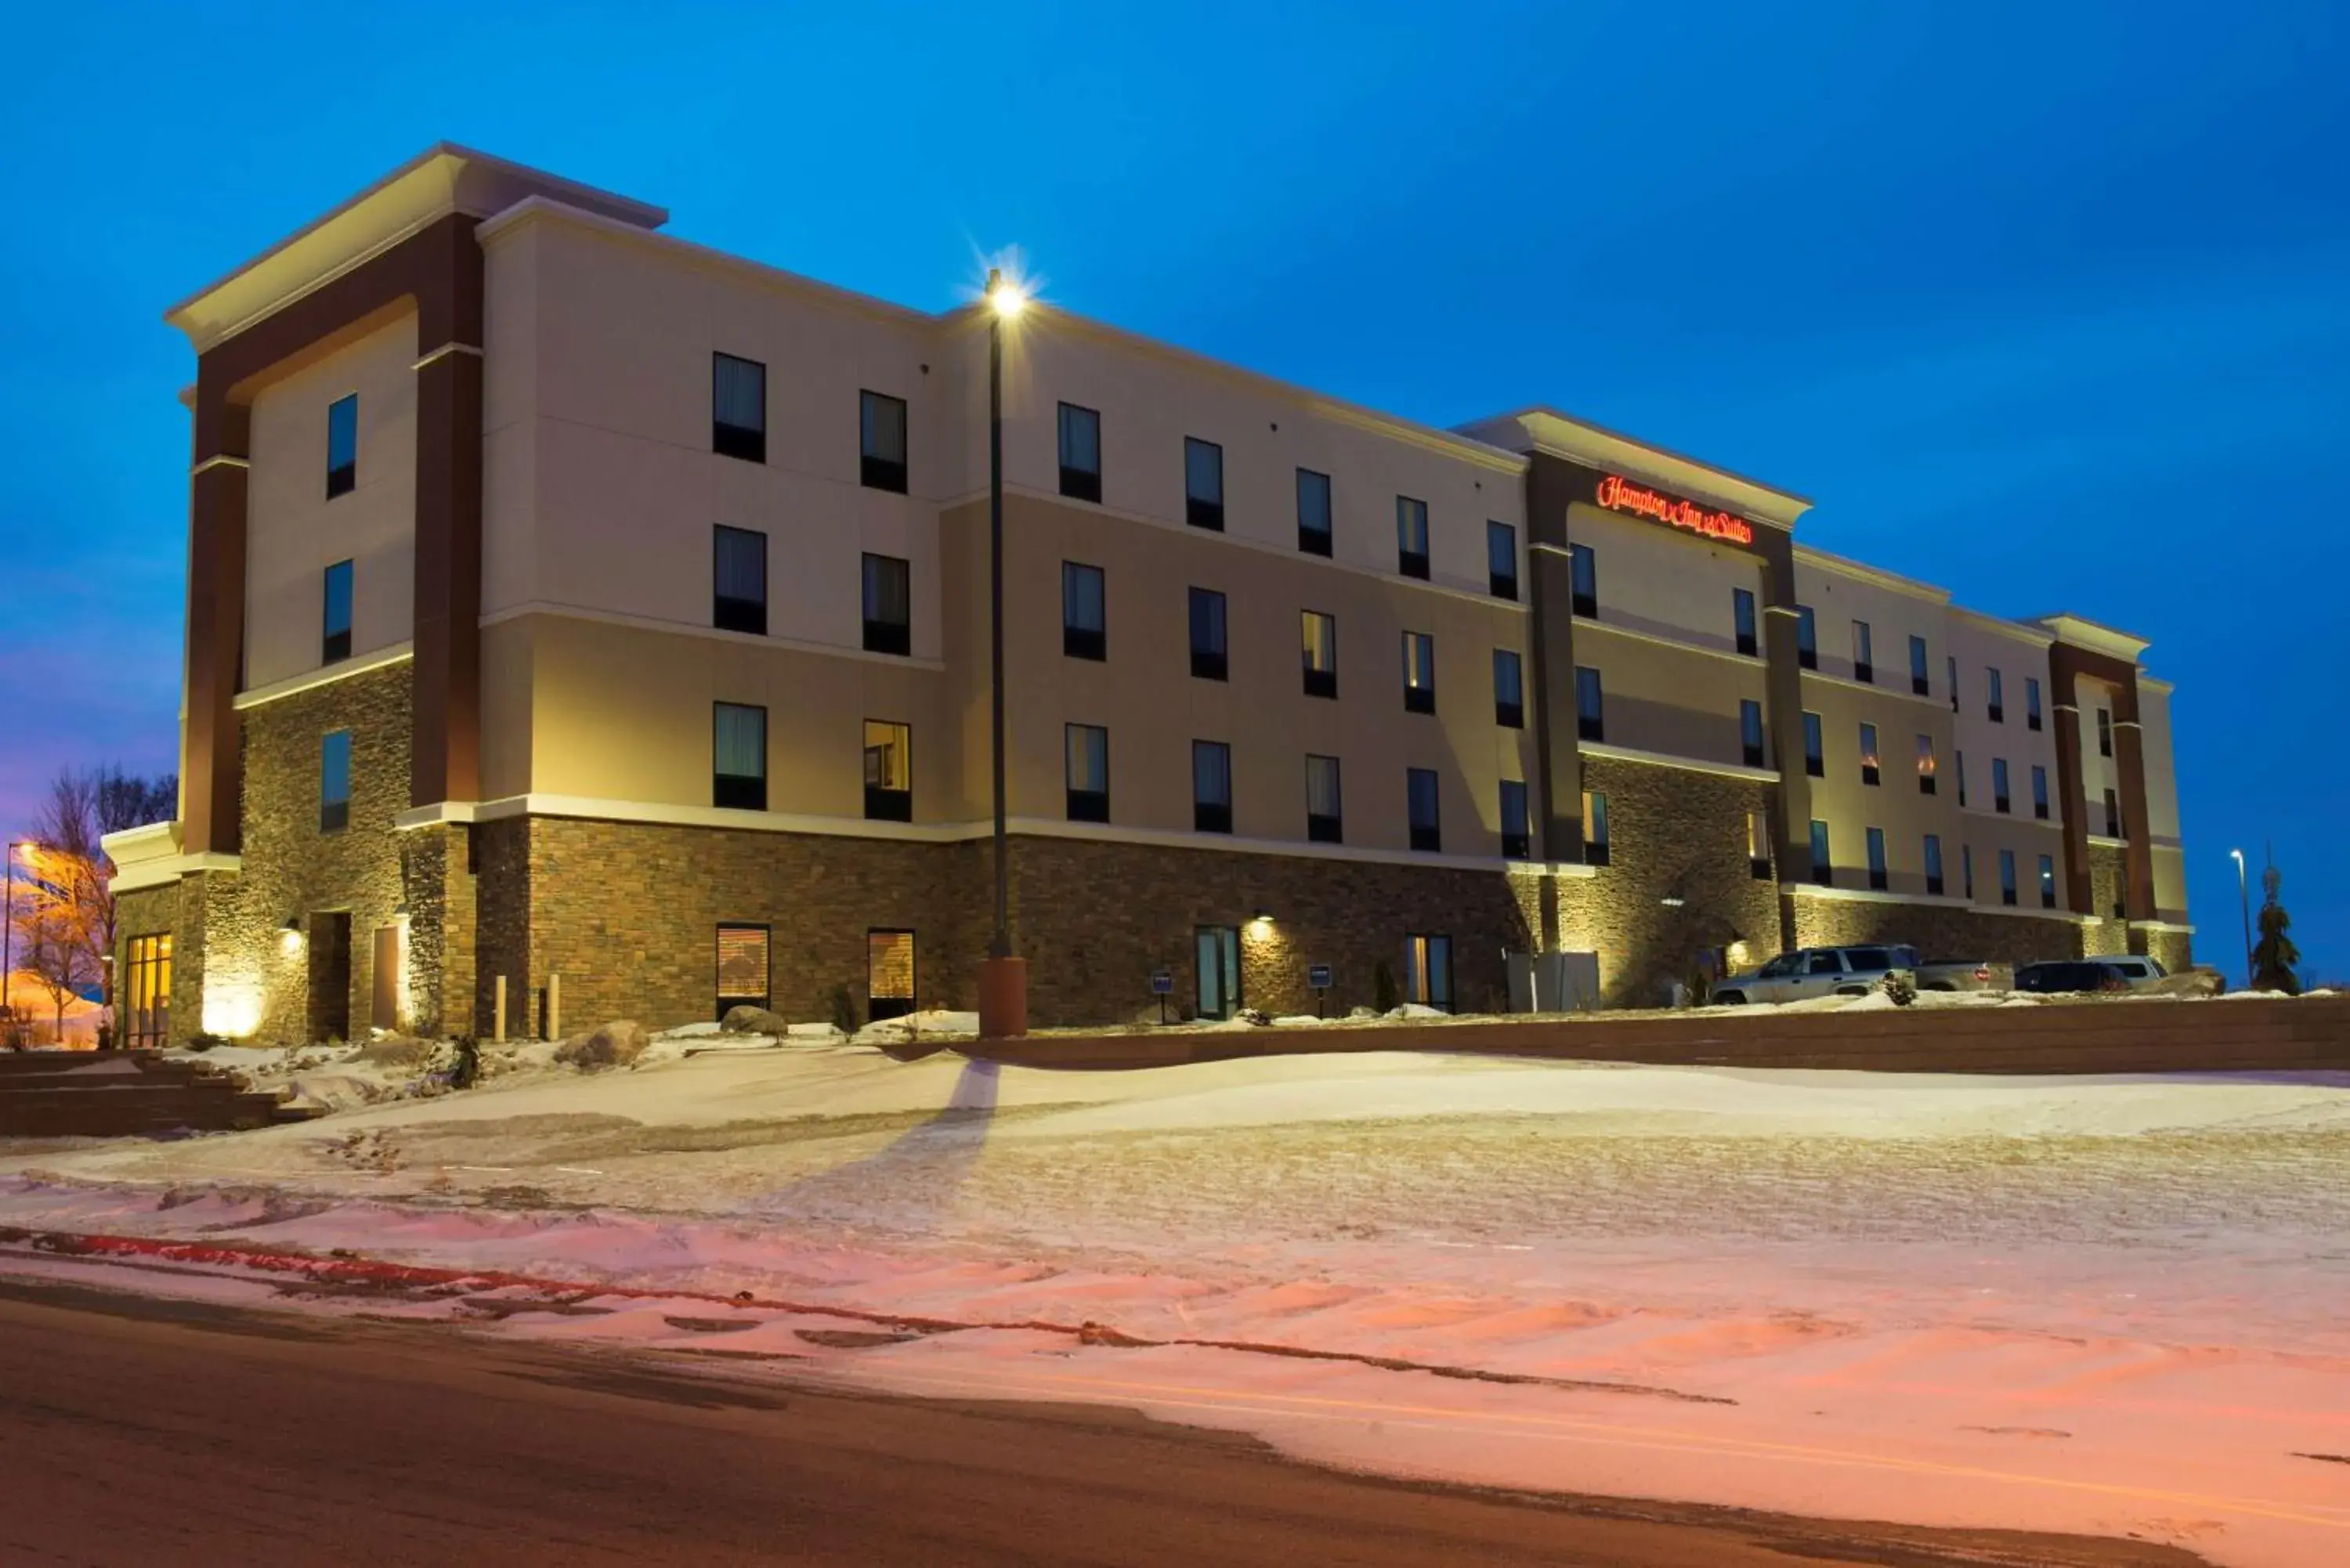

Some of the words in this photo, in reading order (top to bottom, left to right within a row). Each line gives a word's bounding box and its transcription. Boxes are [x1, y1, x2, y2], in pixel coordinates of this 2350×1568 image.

[1597, 476, 1672, 522] Hampton
[1671, 501, 1707, 533] Inn
[1715, 513, 1752, 543] Suites
